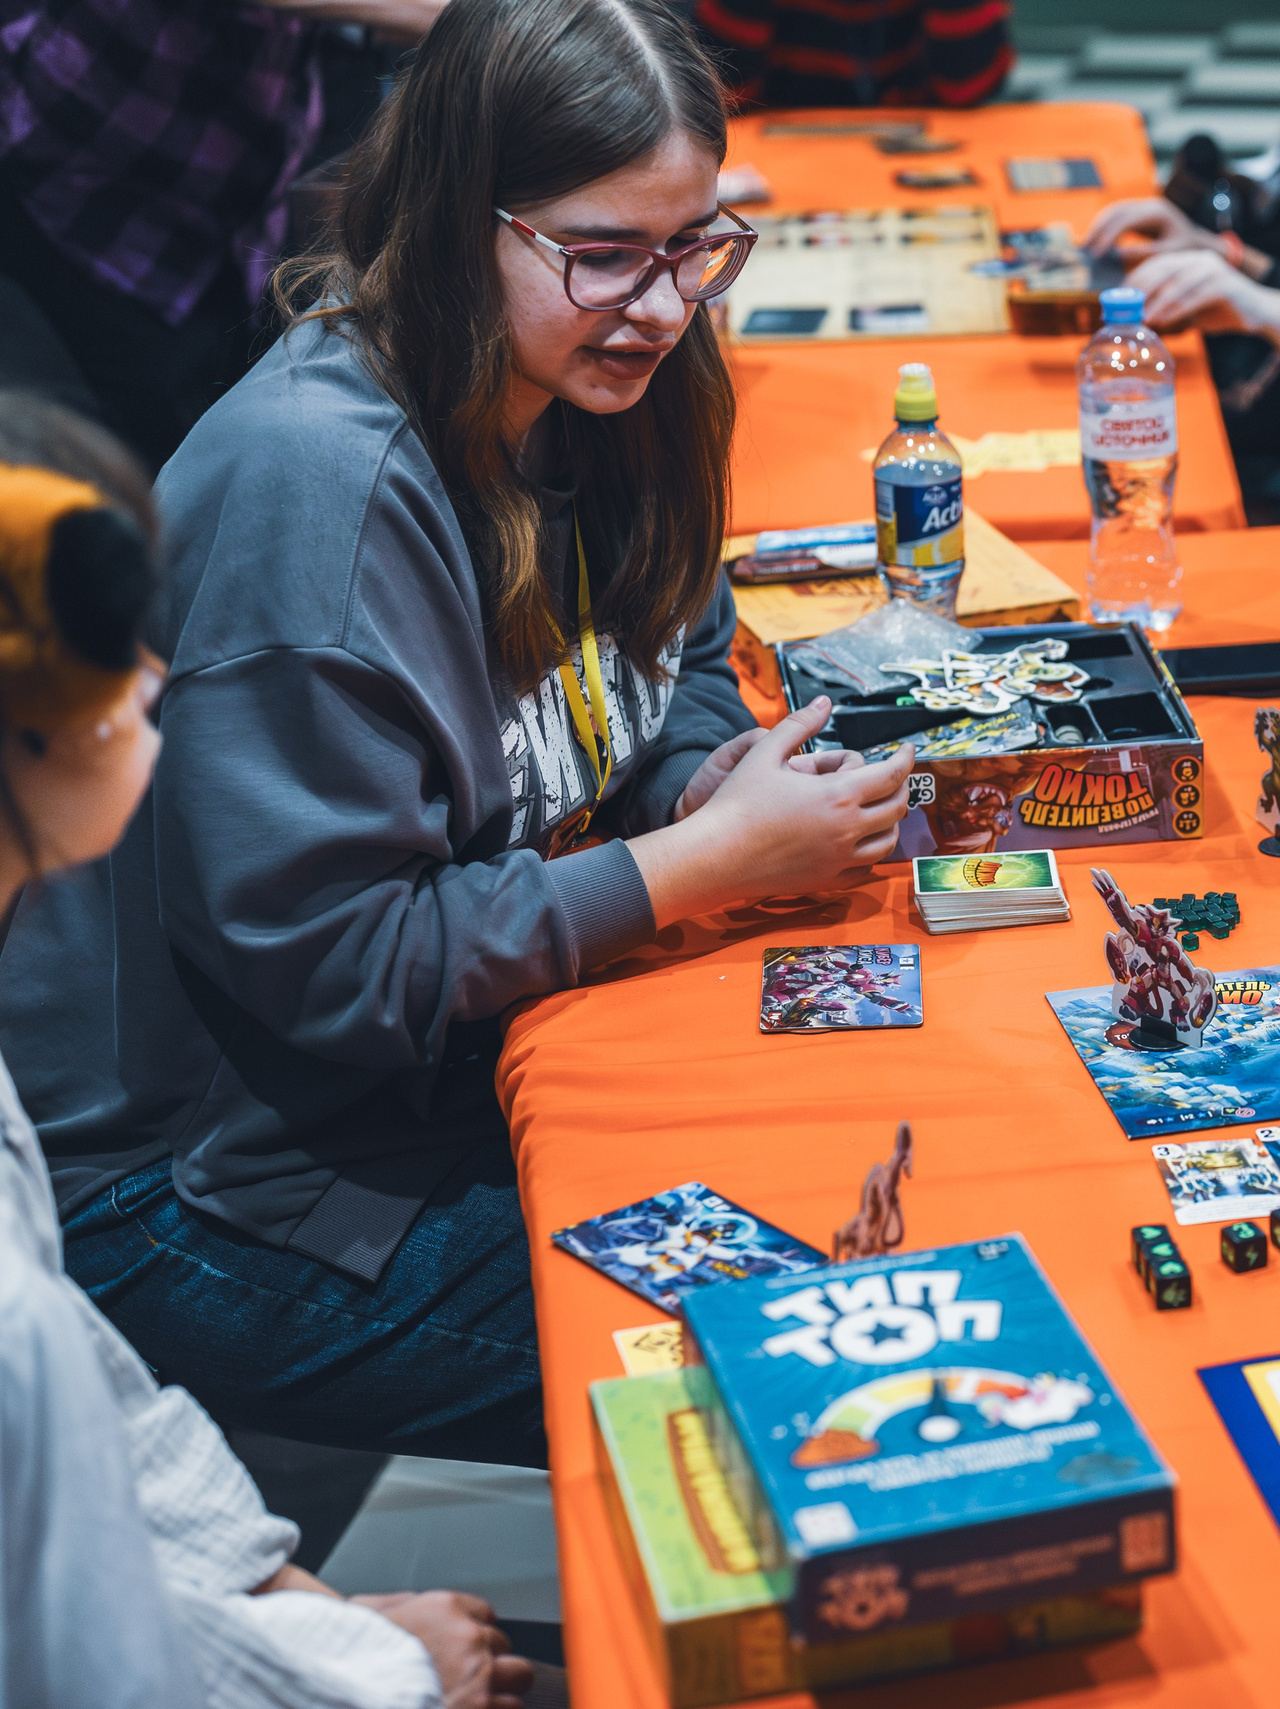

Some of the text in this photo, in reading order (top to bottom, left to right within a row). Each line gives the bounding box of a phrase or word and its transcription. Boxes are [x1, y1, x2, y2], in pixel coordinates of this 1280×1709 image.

[1034, 764, 1148, 807] ТОКИО
[1020, 793, 1154, 827] ПОВЕЛИТЕЛЬ
[857, 949, 873, 964] КИСА
[874, 947, 892, 965] КИБЕР
[1215, 981, 1270, 992] ИТЕЛЬ
[1260, 1129, 1275, 1138] 2
[1158, 1147, 1171, 1157] 3
[760, 1269, 962, 1325] ТИП
[761, 1299, 1003, 1367] ТОП
